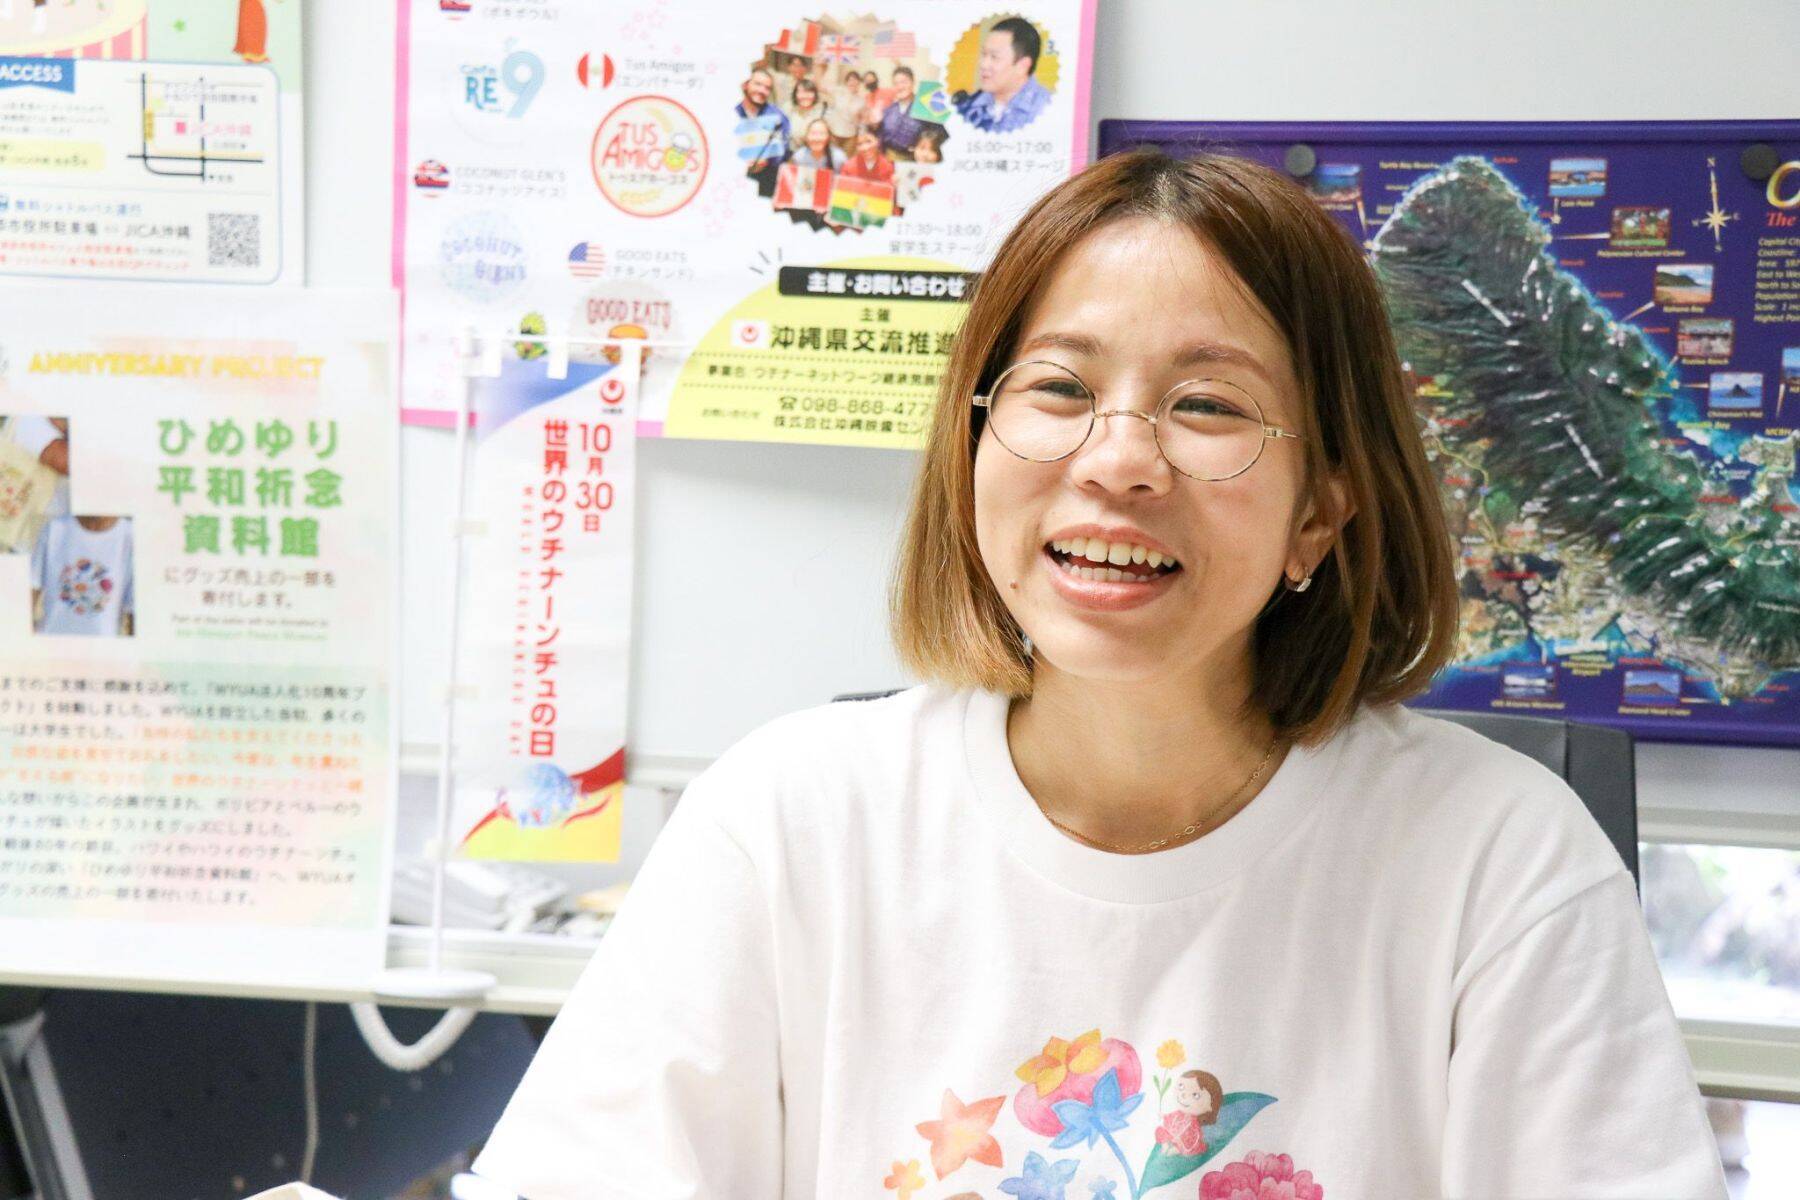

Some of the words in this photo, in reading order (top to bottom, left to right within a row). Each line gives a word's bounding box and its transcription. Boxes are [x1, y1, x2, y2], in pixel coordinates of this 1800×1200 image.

[0, 64, 63, 82] ACCESS
[619, 122, 658, 146] TUS
[29, 353, 203, 378] ANNIVERSARY
[211, 358, 326, 380] PROJECT
[157, 418, 338, 459] ひめゆり
[157, 465, 343, 509] 平和祈念
[574, 423, 614, 532] 10月30日
[182, 514, 321, 557] 資料館
[529, 418, 569, 757] 世界のウチナーンチュの日
